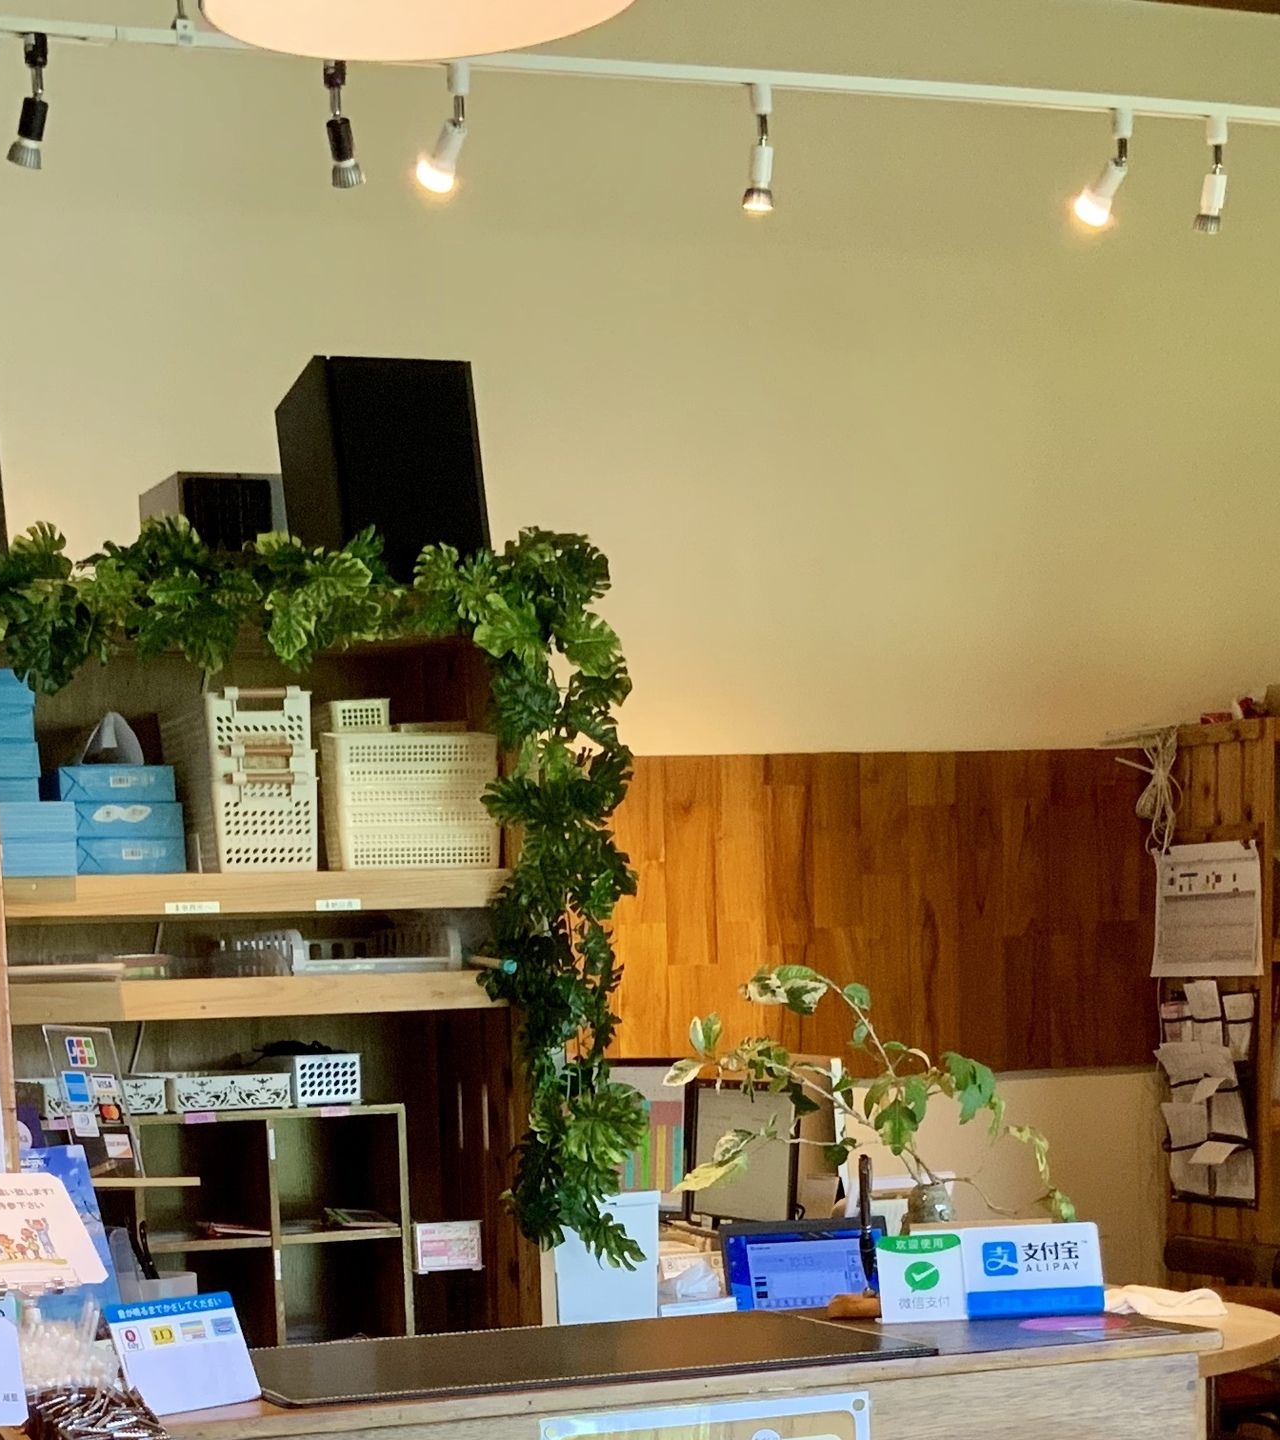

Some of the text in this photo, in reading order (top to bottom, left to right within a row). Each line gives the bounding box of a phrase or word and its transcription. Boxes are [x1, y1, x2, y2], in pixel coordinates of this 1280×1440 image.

[96, 1080, 113, 1088] VISA
[895, 1239, 945, 1251] 欢迎使用
[1022, 1240, 1081, 1262] 支付宝
[1025, 1261, 1080, 1274] ALIPAY
[898, 1294, 950, 1311] 微信支付
